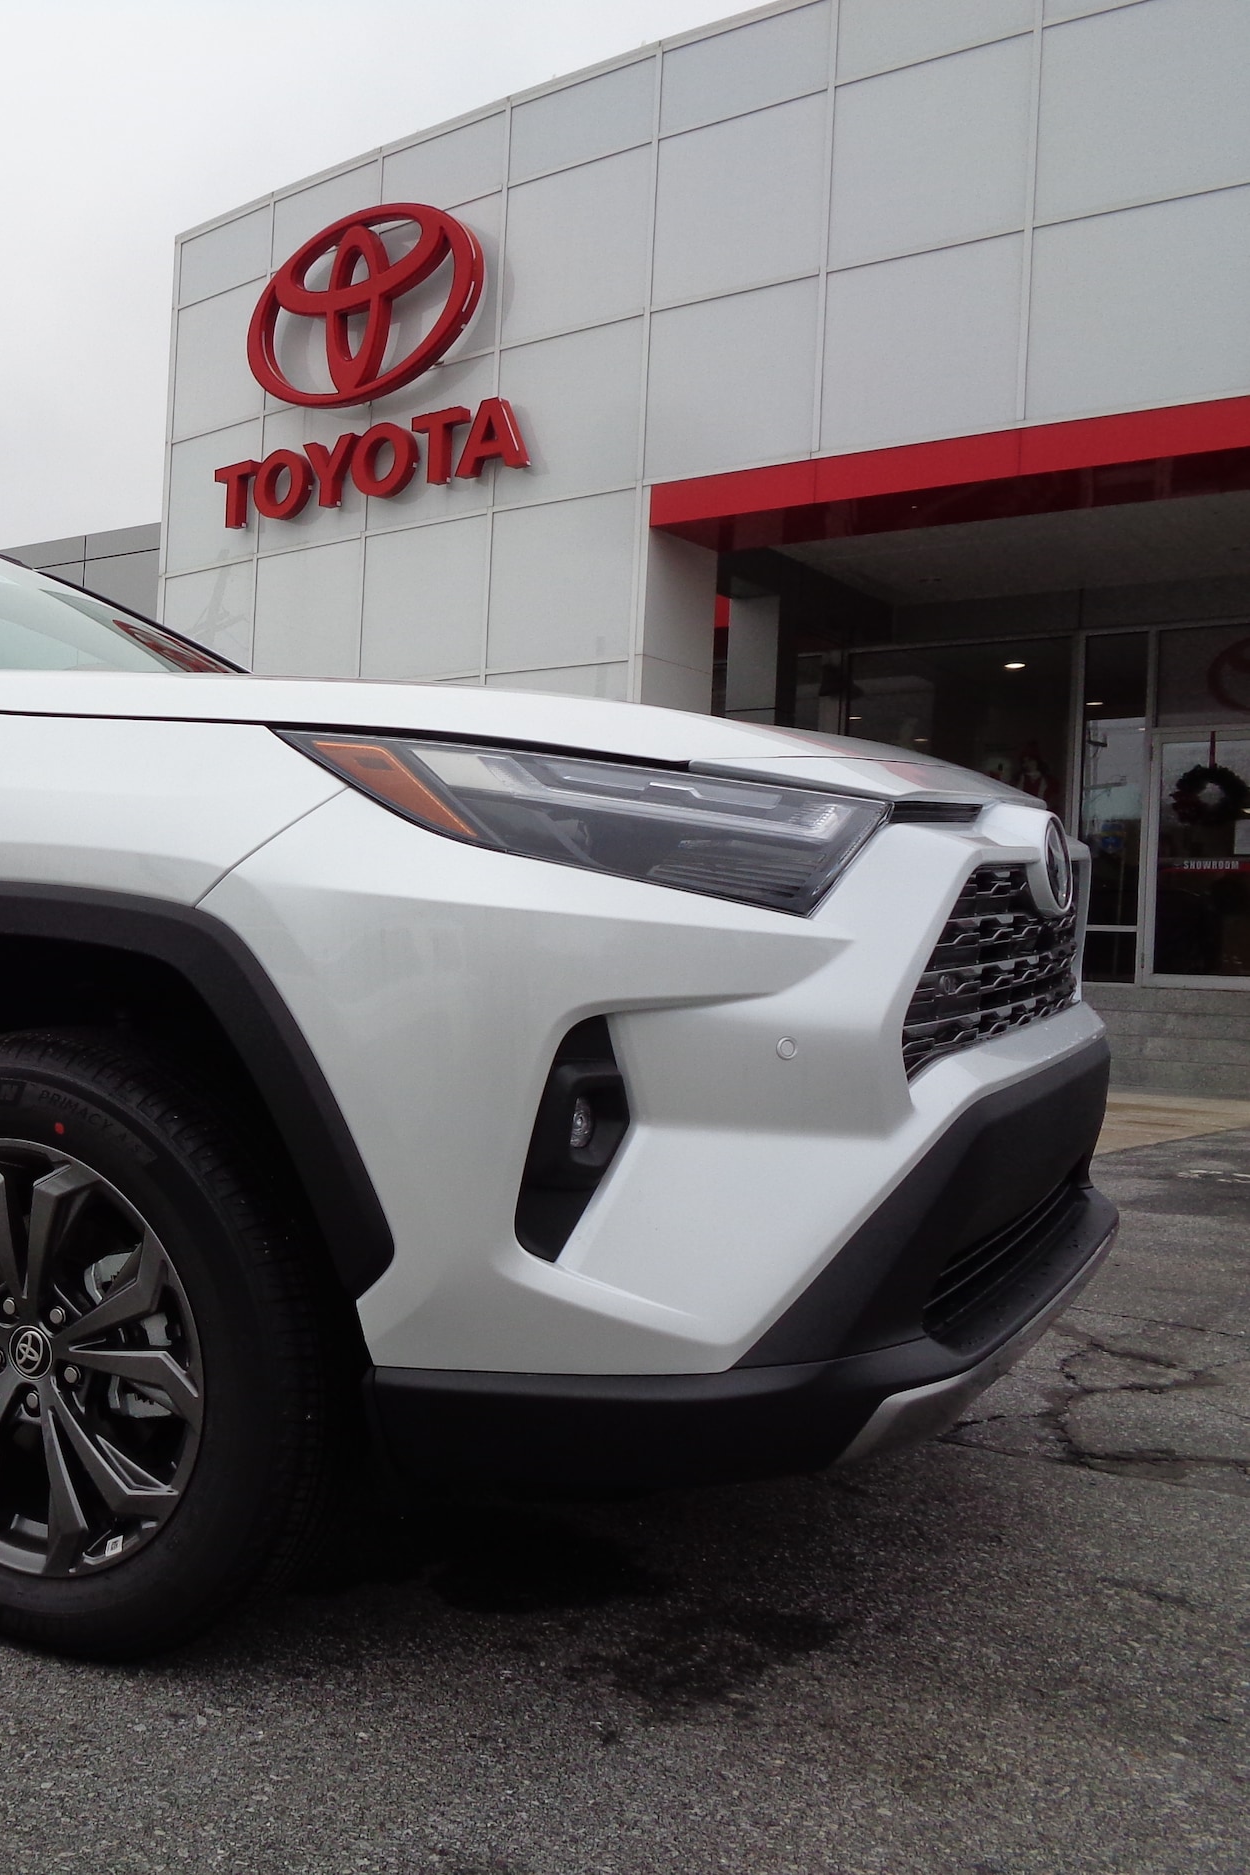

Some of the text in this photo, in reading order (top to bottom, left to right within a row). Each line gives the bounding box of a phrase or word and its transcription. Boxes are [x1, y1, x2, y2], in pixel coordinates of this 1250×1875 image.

[214, 396, 530, 529] TOYOTA
[1183, 860, 1239, 870] SHOWROOM
[38, 1089, 113, 1130] PRIMACY
